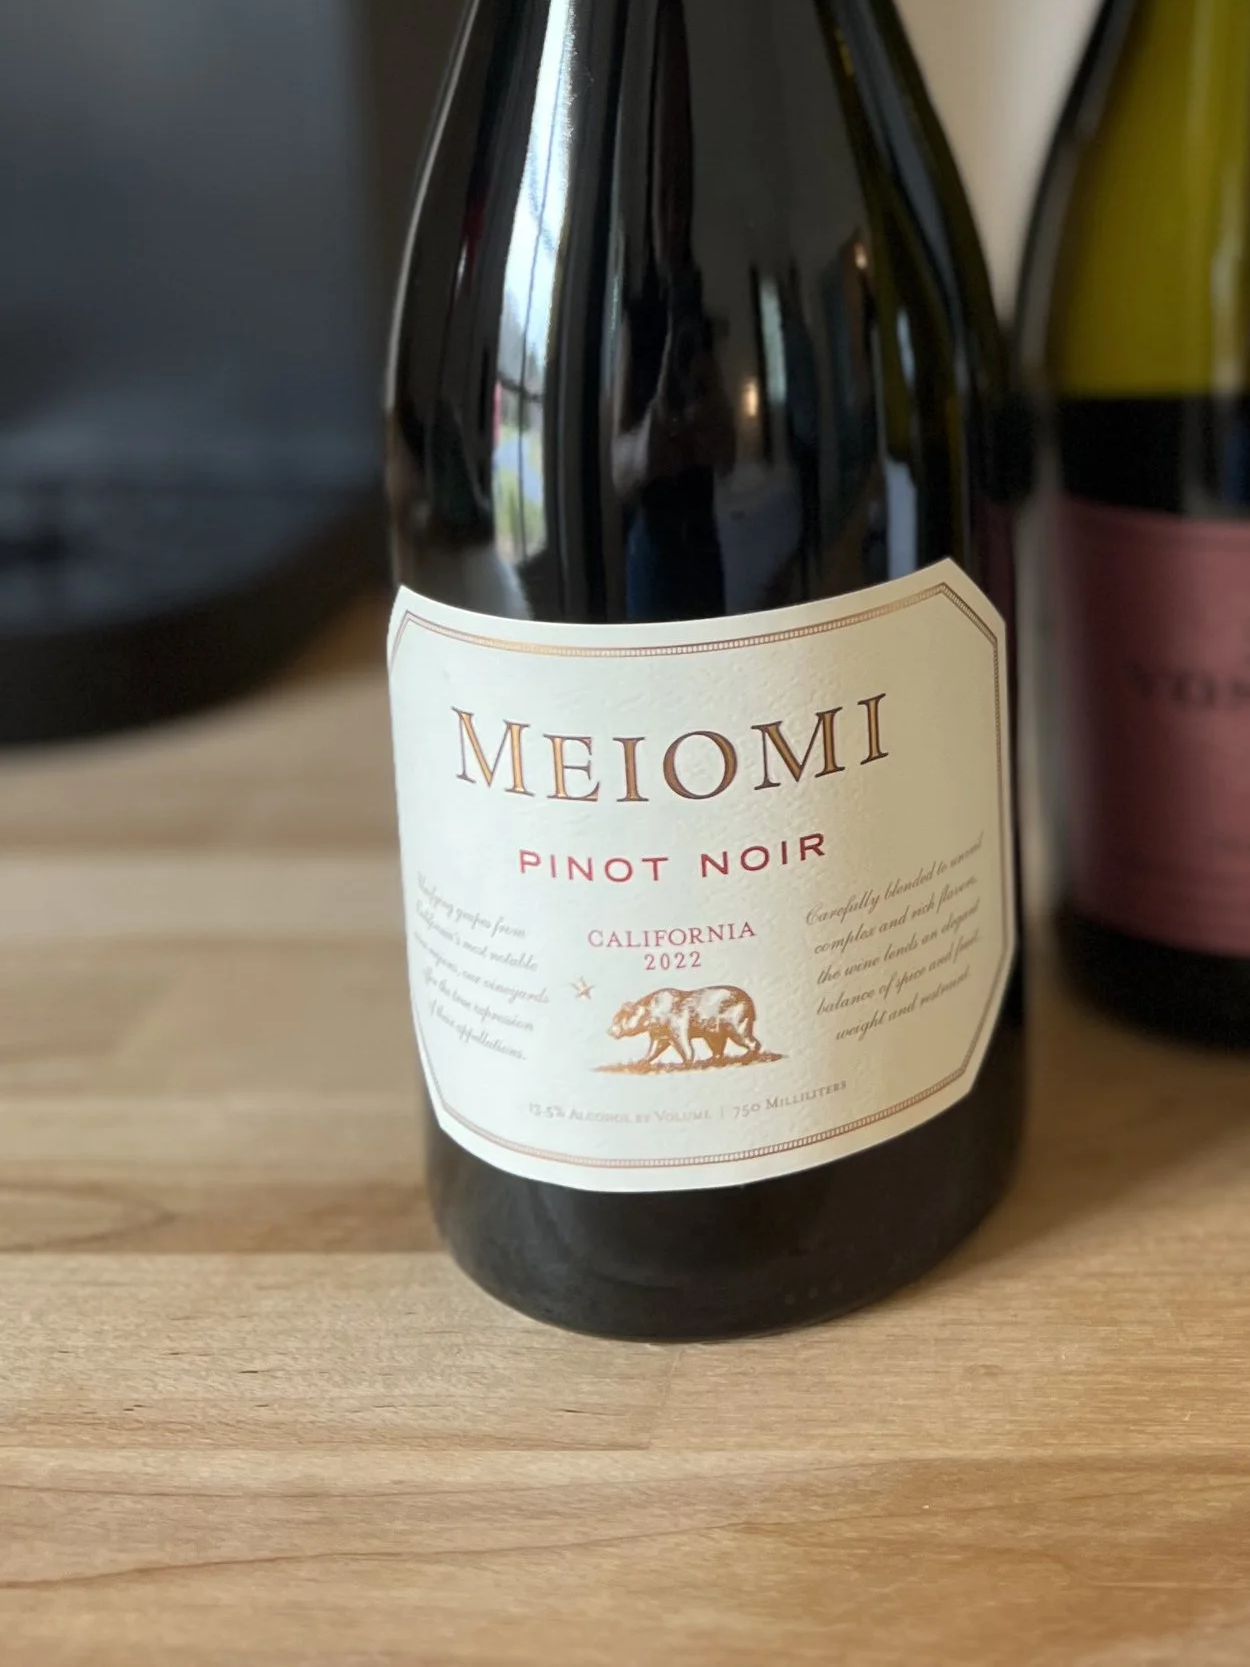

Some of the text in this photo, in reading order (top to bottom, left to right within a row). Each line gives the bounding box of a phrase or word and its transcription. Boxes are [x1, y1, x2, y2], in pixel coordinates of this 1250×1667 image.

[451, 692, 889, 803] MEIOMI
[519, 833, 825, 882] PINOT NOIR
[806, 888, 880, 925] Carefully
[884, 860, 936, 902] blended
[937, 861, 948, 876] to
[588, 921, 757, 948] CALIFORNIA
[814, 922, 875, 954] complex
[879, 905, 910, 932] and
[911, 892, 935, 920] rich
[644, 951, 702, 971] 2022
[816, 965, 841, 985] the
[844, 956, 880, 977] wine
[883, 932, 919, 962] lends
[921, 930, 938, 946] an
[816, 990, 875, 1016] balance
[879, 975, 896, 1001] of
[895, 965, 926, 994] spice
[928, 941, 954, 971] and
[836, 1011, 887, 1042] weight
[888, 992, 919, 1022] and
[733, 1102, 762, 1120] 750
